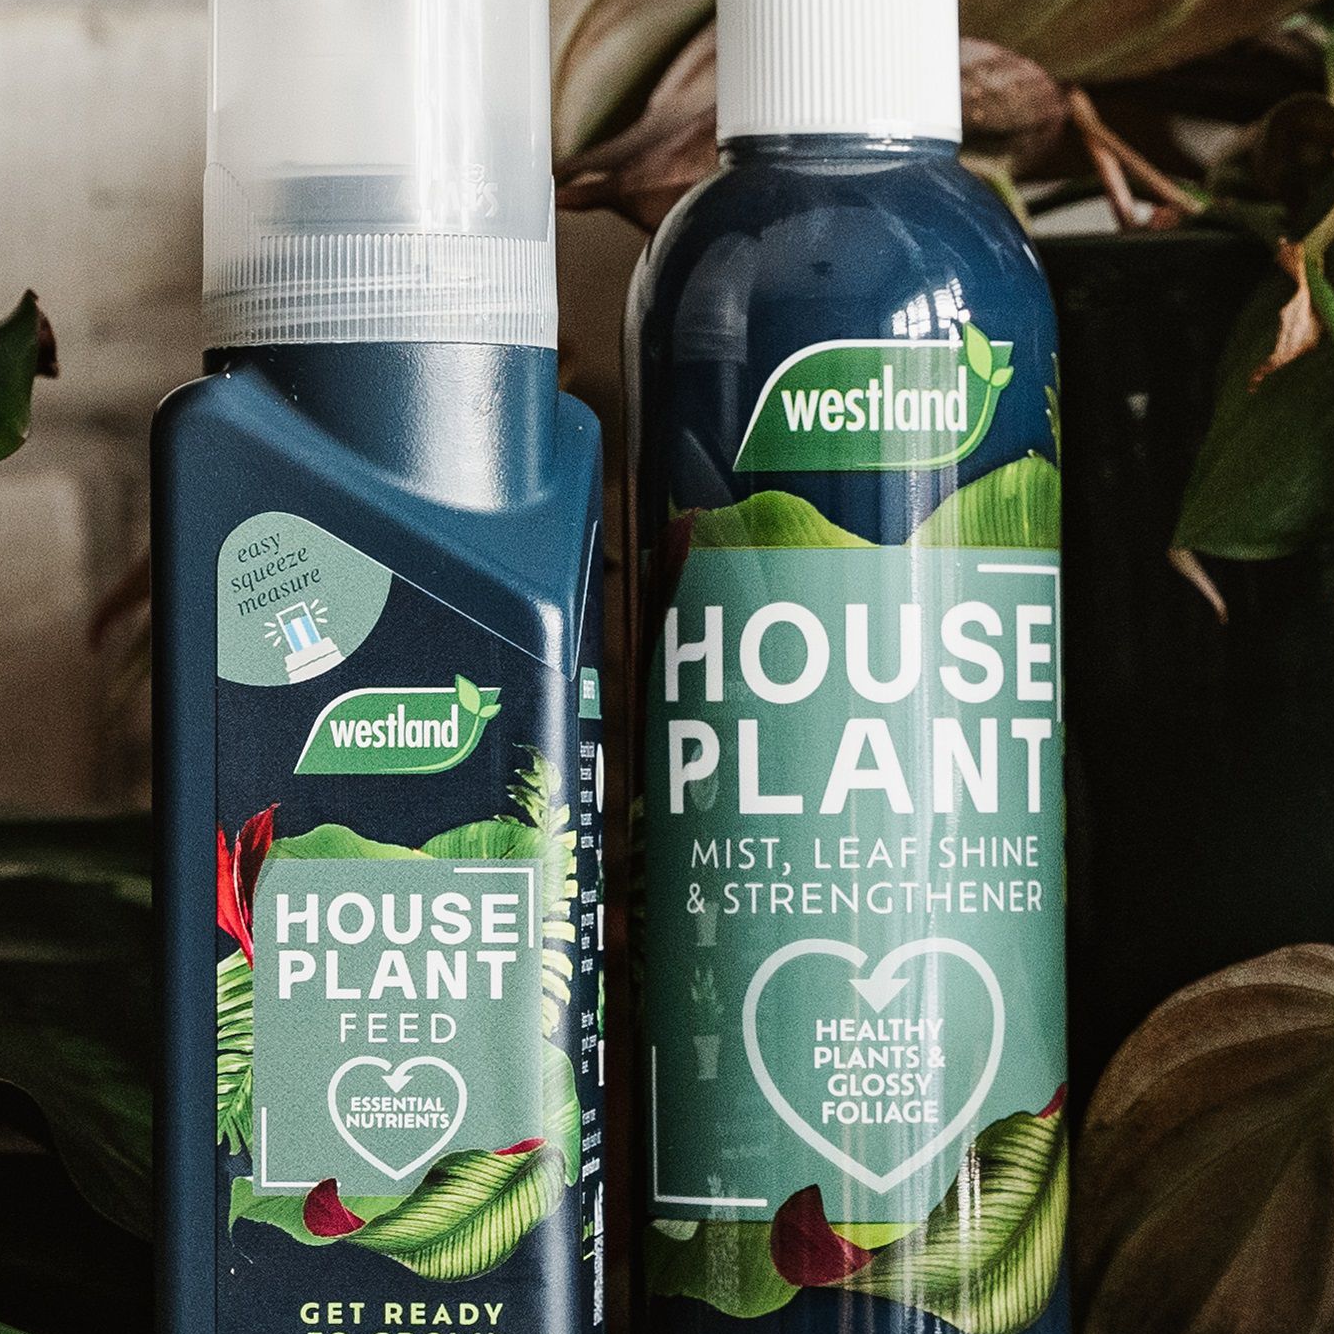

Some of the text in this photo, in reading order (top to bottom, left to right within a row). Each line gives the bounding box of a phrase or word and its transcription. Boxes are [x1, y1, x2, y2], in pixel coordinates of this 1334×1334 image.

[780, 363, 969, 433] westland
[238, 533, 280, 563] easy
[231, 547, 309, 593] squeeze
[237, 568, 322, 616] measure
[664, 600, 1055, 705] HOUSE
[329, 704, 460, 749] westland
[667, 717, 1054, 816] PLANT
[691, 835, 1040, 875] MIST, LEAF SHINE
[685, 880, 1043, 915] & STRENGTHENER
[275, 892, 520, 945] HOUSE
[277, 950, 517, 1000] PLANT
[340, 1013, 457, 1043] FEED
[815, 1018, 945, 1043] HEALTHY
[813, 1045, 947, 1069] PLANTS &
[826, 1073, 933, 1097] GLOSSY
[345, 1113, 450, 1130] NUTRIENTS
[350, 1097, 445, 1113] ESSENTIAL
[821, 1100, 940, 1125] FOLIAGE
[300, 1302, 505, 1325] GET READY
